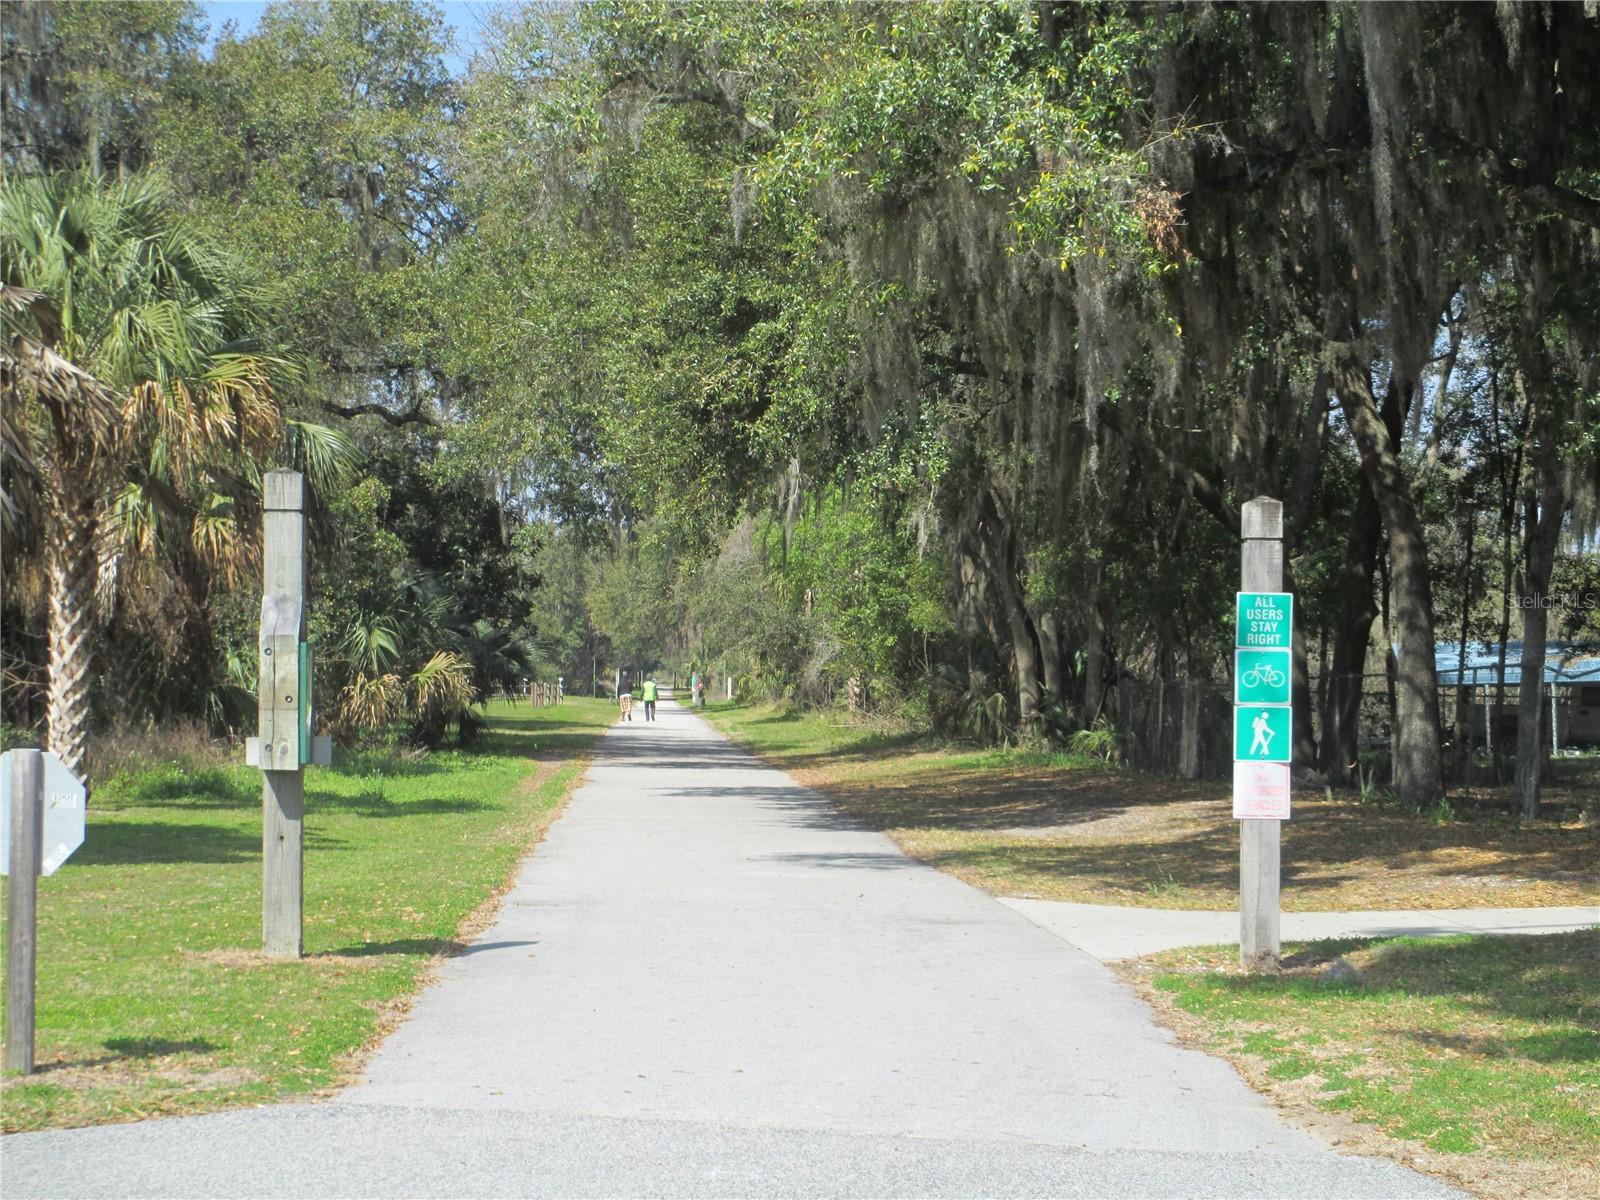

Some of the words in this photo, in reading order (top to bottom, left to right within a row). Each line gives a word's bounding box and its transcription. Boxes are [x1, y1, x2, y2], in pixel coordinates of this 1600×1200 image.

[1255, 596, 1276, 608] ALL
[1246, 608, 1284, 620] USERS
[1251, 621, 1278, 633] STAY
[1247, 633, 1281, 645] RIGHT
